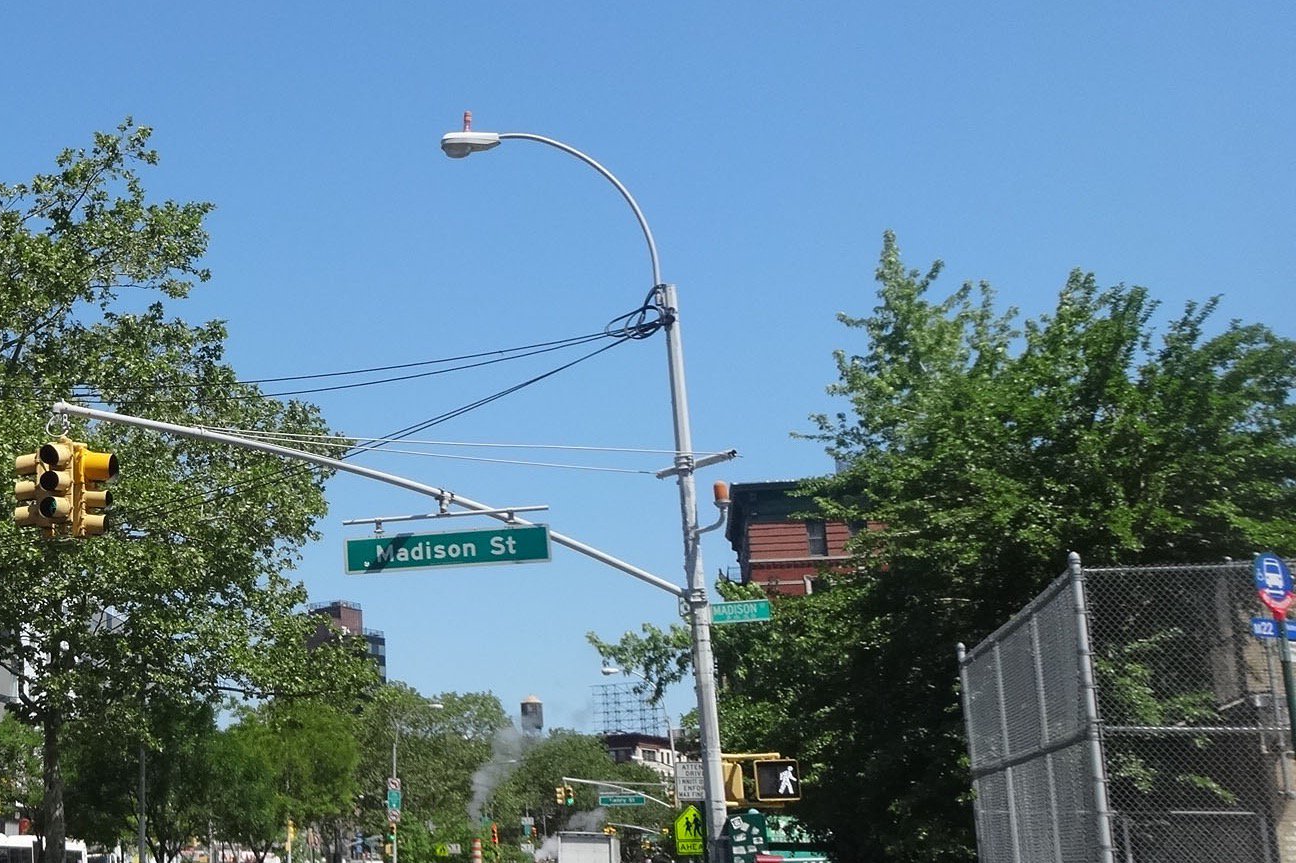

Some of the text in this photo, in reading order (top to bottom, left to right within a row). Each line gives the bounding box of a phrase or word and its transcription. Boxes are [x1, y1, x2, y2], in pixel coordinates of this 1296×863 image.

[376, 536, 517, 563] Madison St
[713, 603, 757, 616] MADISON
[1253, 621, 1275, 635] M22
[680, 843, 703, 851] AHEA
